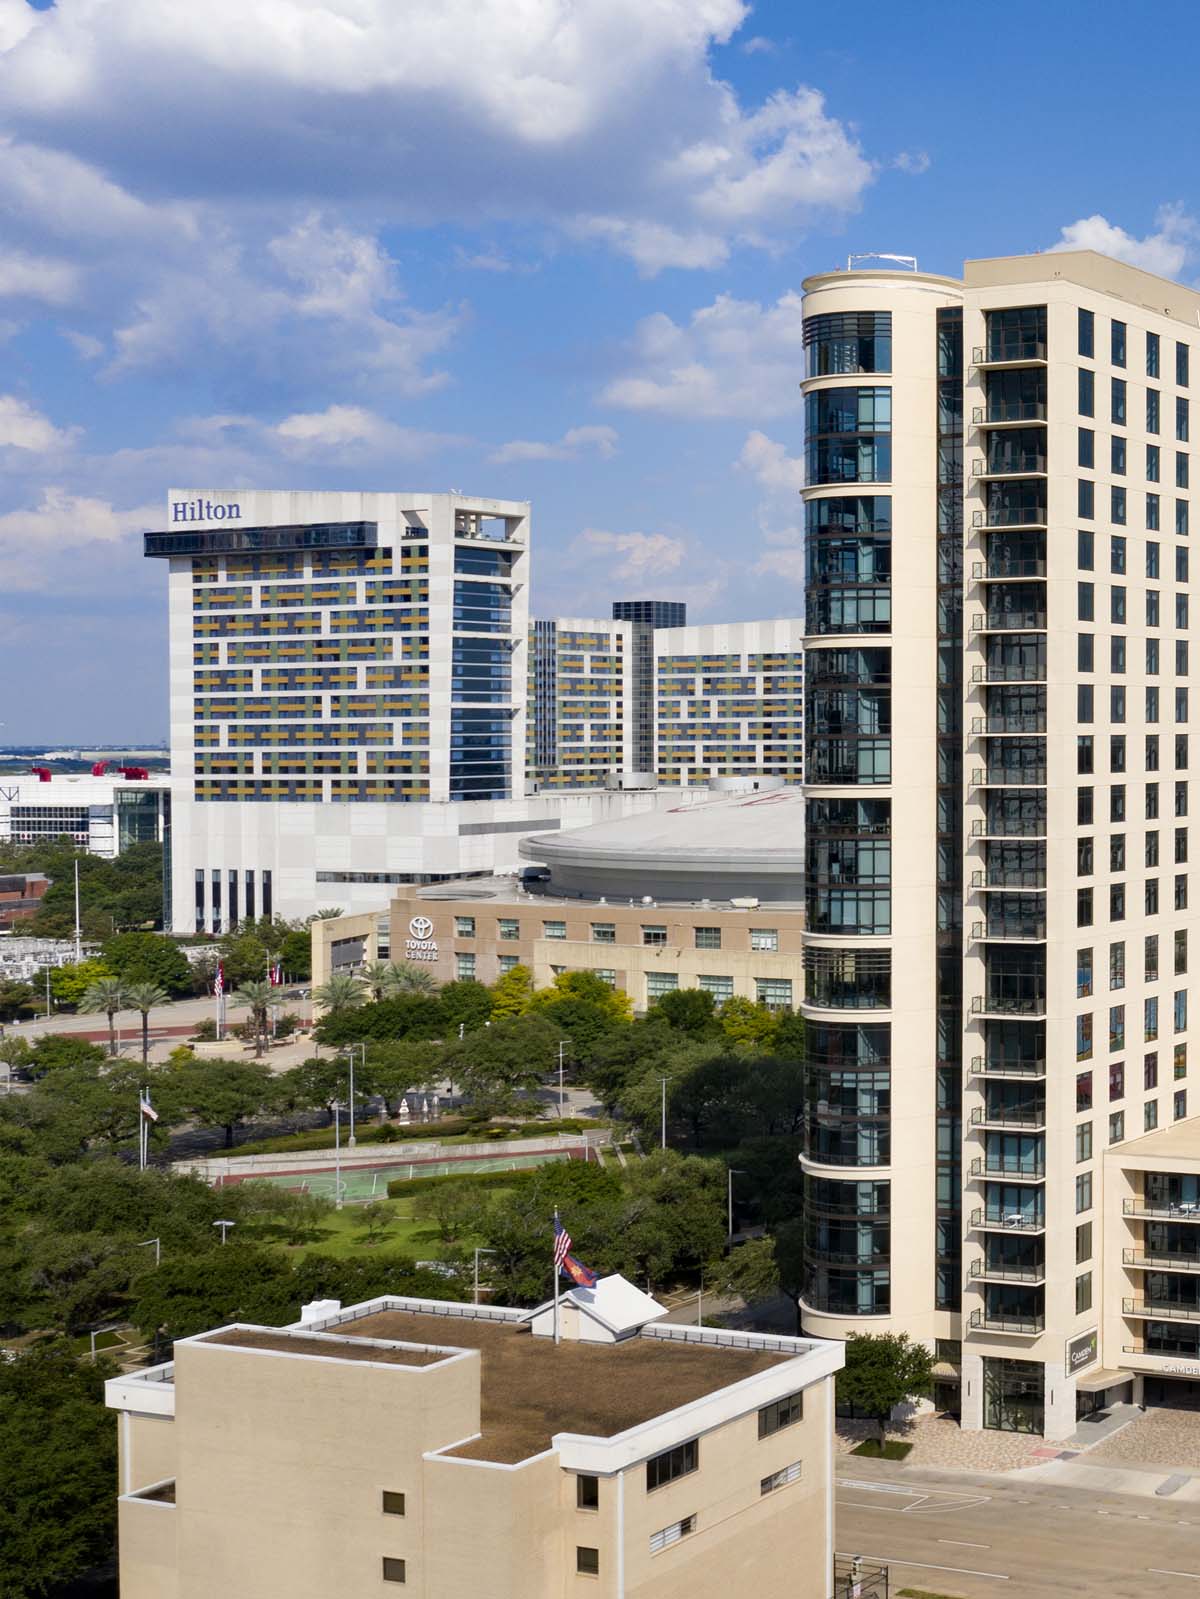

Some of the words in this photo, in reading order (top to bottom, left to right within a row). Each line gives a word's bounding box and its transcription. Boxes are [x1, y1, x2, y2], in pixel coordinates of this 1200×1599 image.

[172, 499, 242, 522] Hilton
[405, 940, 438, 951] TOYOTA
[405, 951, 439, 961] CENTER
